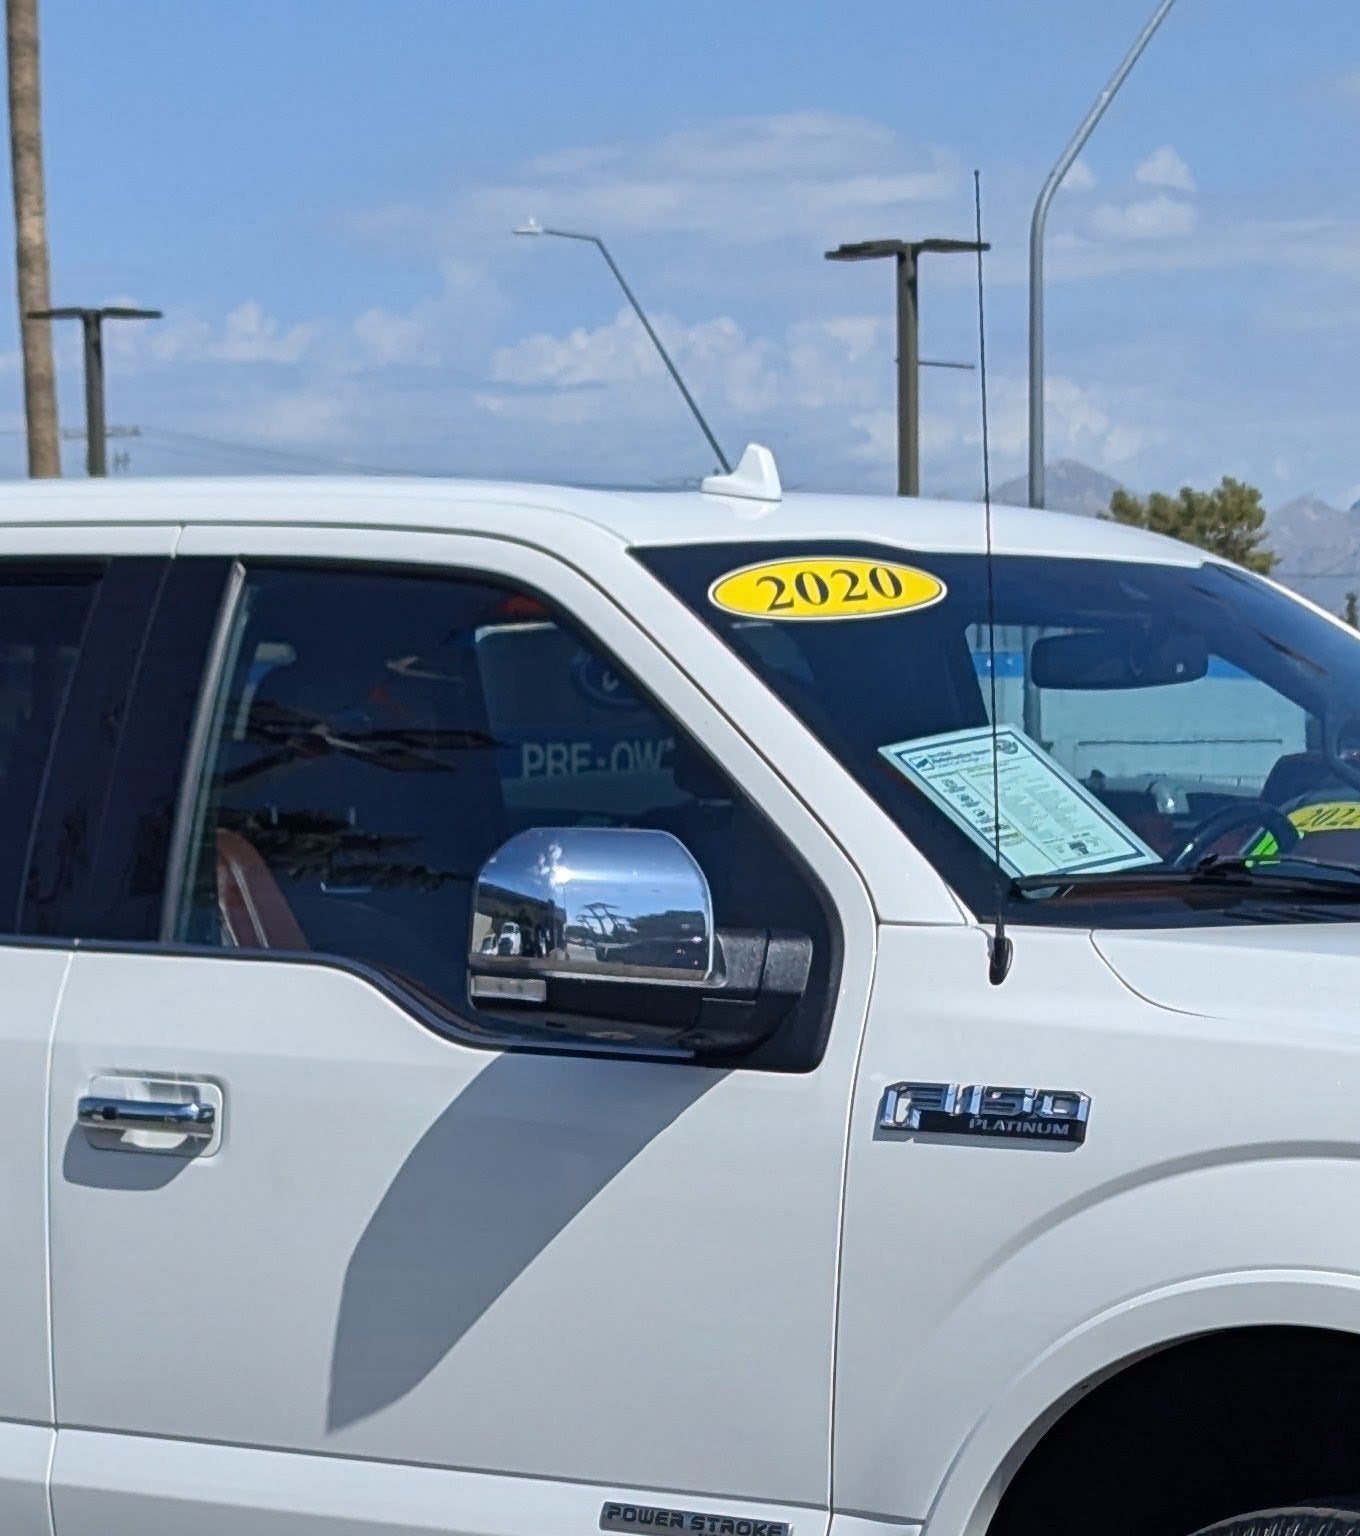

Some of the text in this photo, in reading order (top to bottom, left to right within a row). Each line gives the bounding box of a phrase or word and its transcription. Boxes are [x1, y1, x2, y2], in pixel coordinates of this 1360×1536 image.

[755, 566, 903, 612] 2020
[520, 737, 676, 778] PRE-OW
[968, 1117, 1070, 1136] PLATINUM
[606, 1504, 685, 1530] POWER
